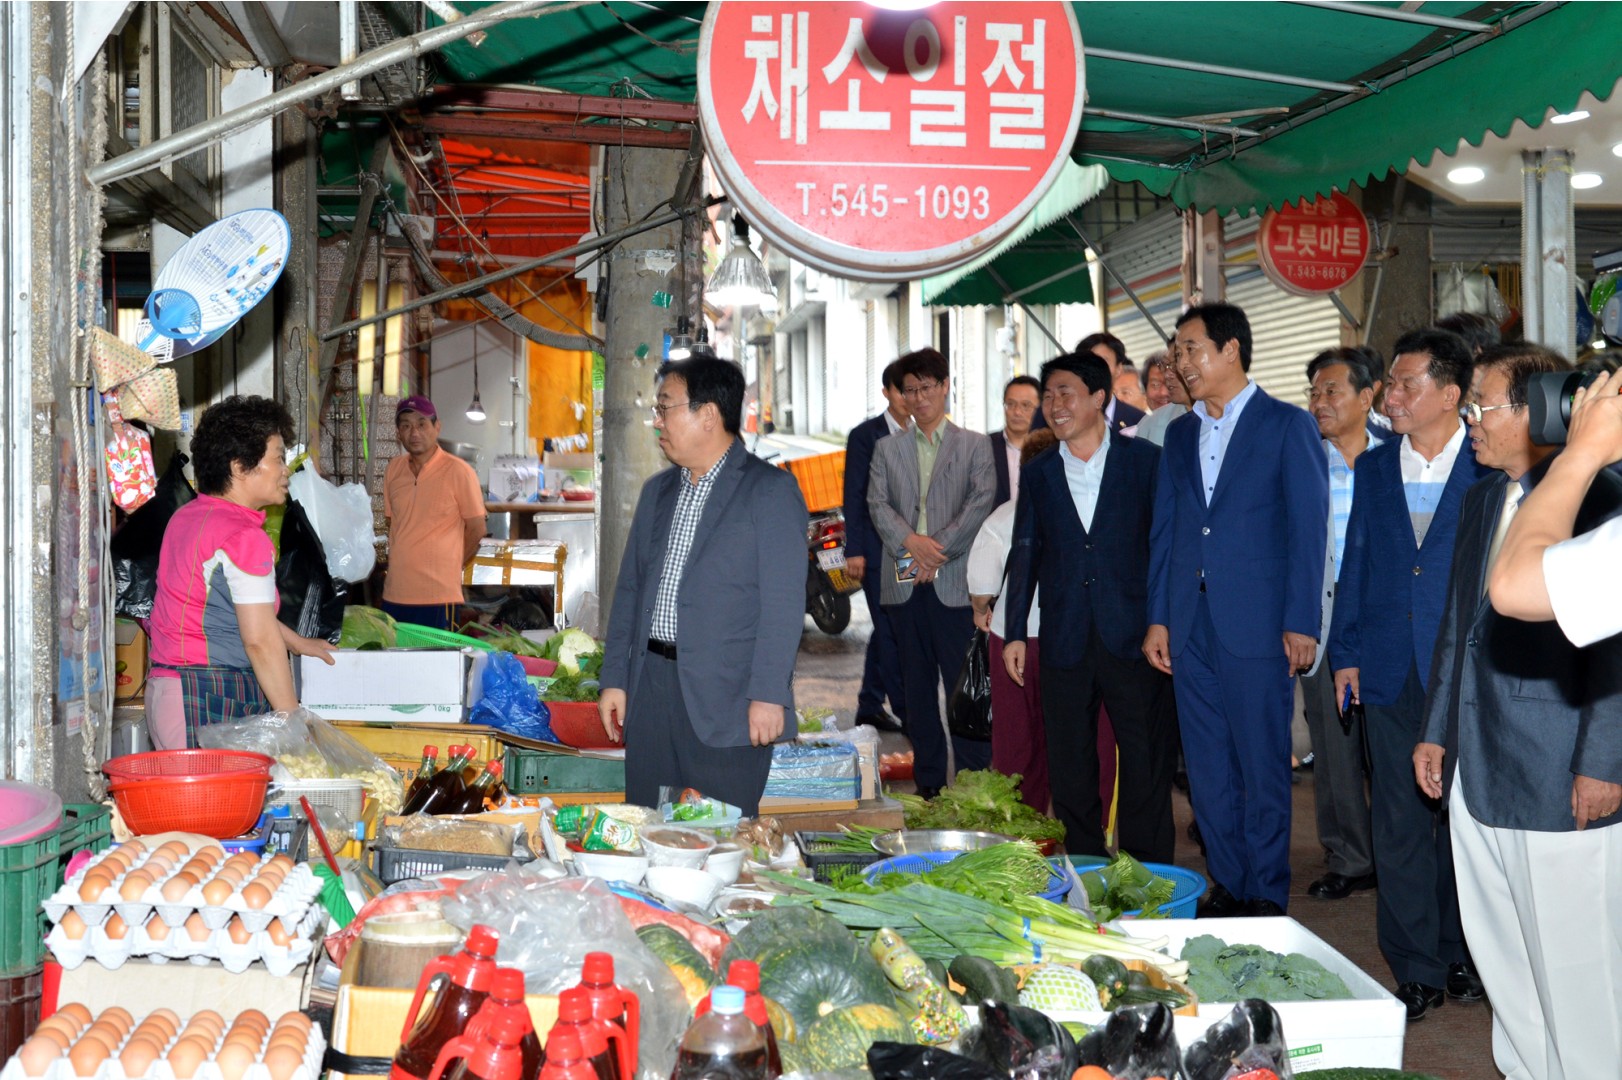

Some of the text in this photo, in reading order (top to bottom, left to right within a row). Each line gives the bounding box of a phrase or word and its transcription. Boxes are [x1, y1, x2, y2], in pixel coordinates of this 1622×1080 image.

[741, 11, 1046, 149] 채소일절
[795, 182, 990, 220] T.545-1093
[1274, 223, 1361, 258] 그릇마트
